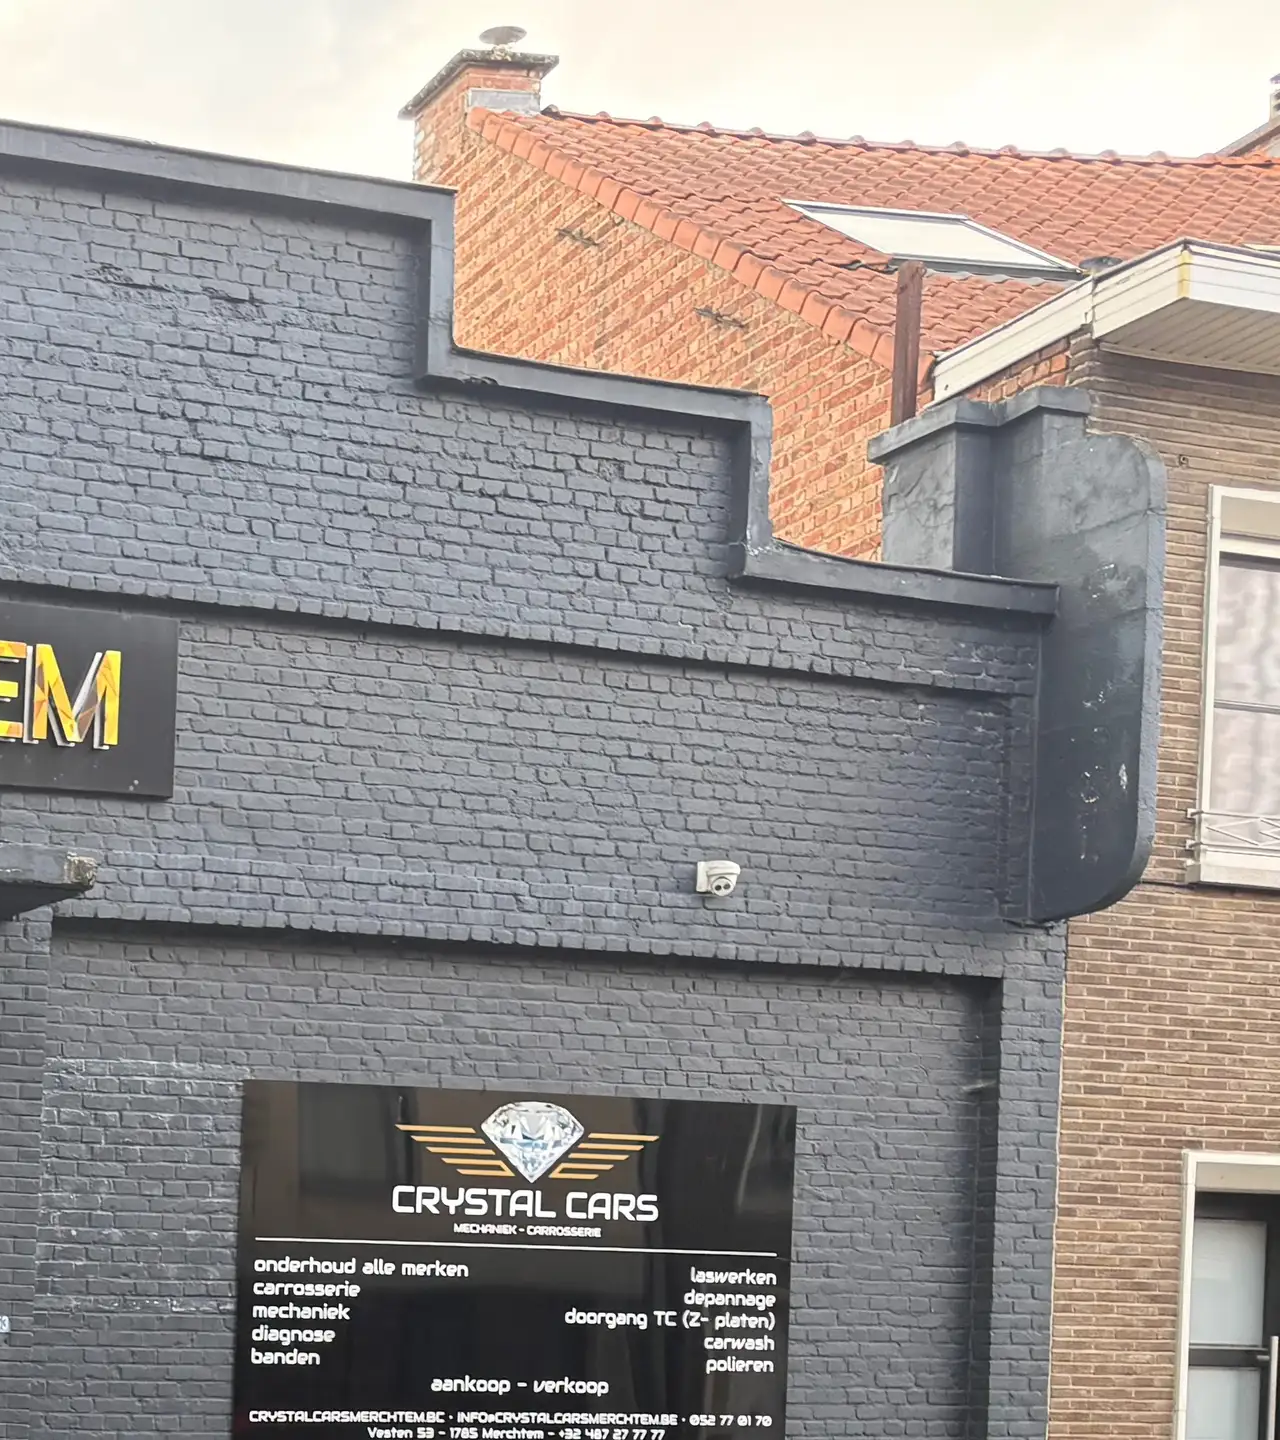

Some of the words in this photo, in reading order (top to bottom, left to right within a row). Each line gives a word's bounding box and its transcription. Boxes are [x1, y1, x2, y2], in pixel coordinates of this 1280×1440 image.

[392, 1185, 556, 1218] CRYSTAL
[566, 1192, 658, 1221] CARS
[454, 1223, 517, 1234] MECHANIEK
[527, 1226, 601, 1237] CARROSSERIE
[254, 1256, 356, 1274] onderhoud
[362, 1258, 395, 1275] alle
[402, 1260, 468, 1277] merken
[691, 1267, 776, 1285] laswerken
[253, 1280, 360, 1297] carrosserie
[684, 1289, 776, 1311] depannage
[253, 1302, 350, 1319] mechaniek
[565, 1308, 647, 1329] doorgang
[653, 1311, 677, 1326] TC
[682, 1310, 709, 1328] (Z-
[715, 1312, 775, 1330] platen)
[252, 1325, 335, 1345] diagnose
[704, 1335, 774, 1350] carwash
[251, 1348, 320, 1365] banden
[706, 1356, 774, 1374] polieren
[431, 1375, 510, 1395] aankoop
[534, 1377, 609, 1397] verkoop
[690, 1415, 715, 1426] 052
[720, 1415, 734, 1425] 77
[737, 1415, 751, 1426] 01
[755, 1416, 772, 1426] 70
[367, 1427, 413, 1438] Vesten
[417, 1427, 434, 1438] 53
[450, 1427, 478, 1439] 1785
[482, 1427, 544, 1439] Merchtem
[559, 1428, 581, 1439] +32
[585, 1429, 609, 1439] 487
[613, 1429, 629, 1440] 27
[632, 1429, 647, 1440] 77
[651, 1429, 665, 1440] 77
